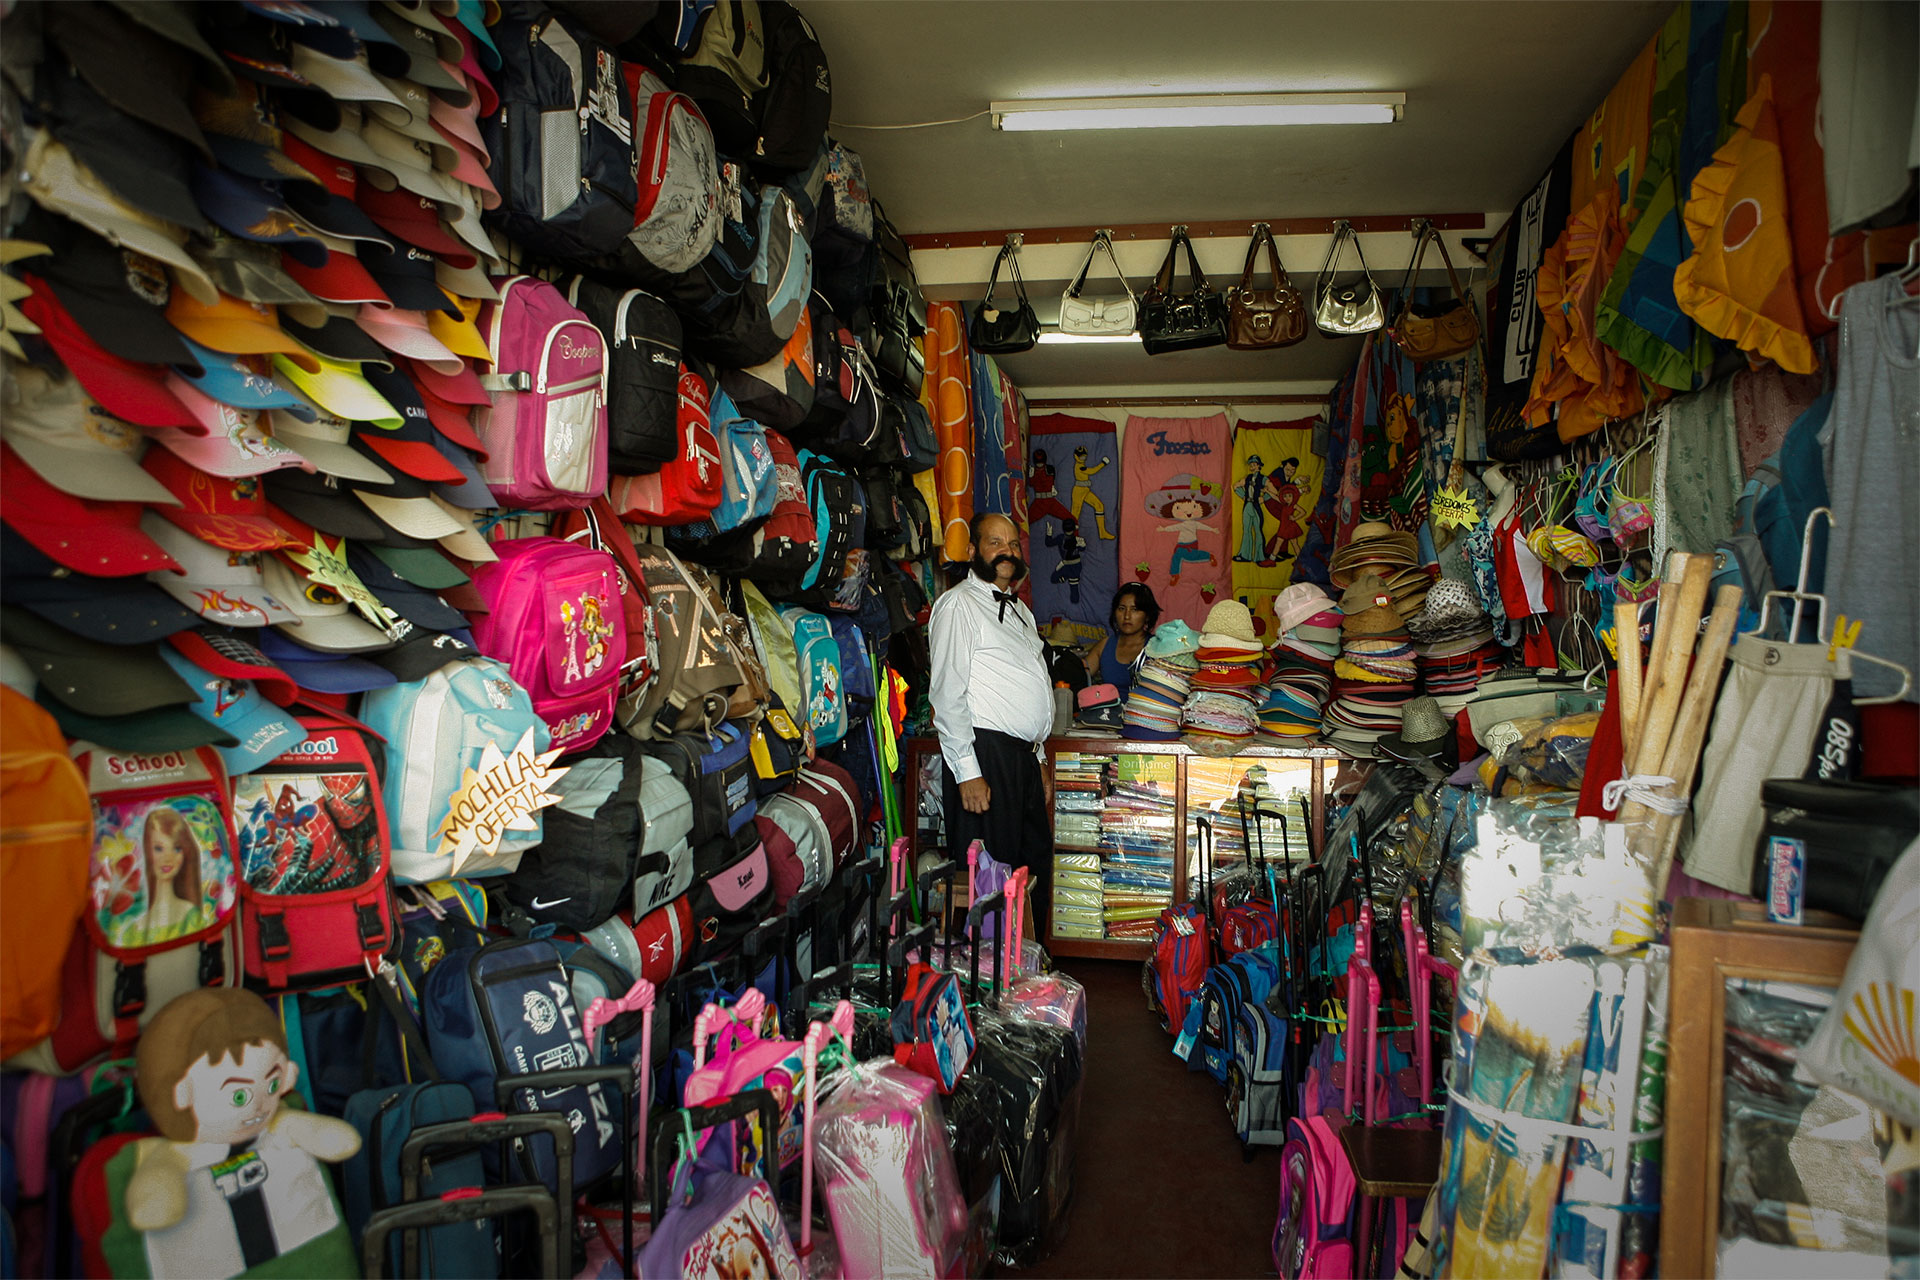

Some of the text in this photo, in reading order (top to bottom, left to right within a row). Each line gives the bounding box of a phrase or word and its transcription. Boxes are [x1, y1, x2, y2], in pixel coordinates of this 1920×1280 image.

[1510, 268, 1527, 323] CLUB
[1438, 506, 1464, 521] OFERTA
[108, 750, 187, 775] School
[475, 782, 550, 846] OFERTA
[648, 874, 675, 906] NIKE
[548, 981, 614, 1149] ALIAZA
